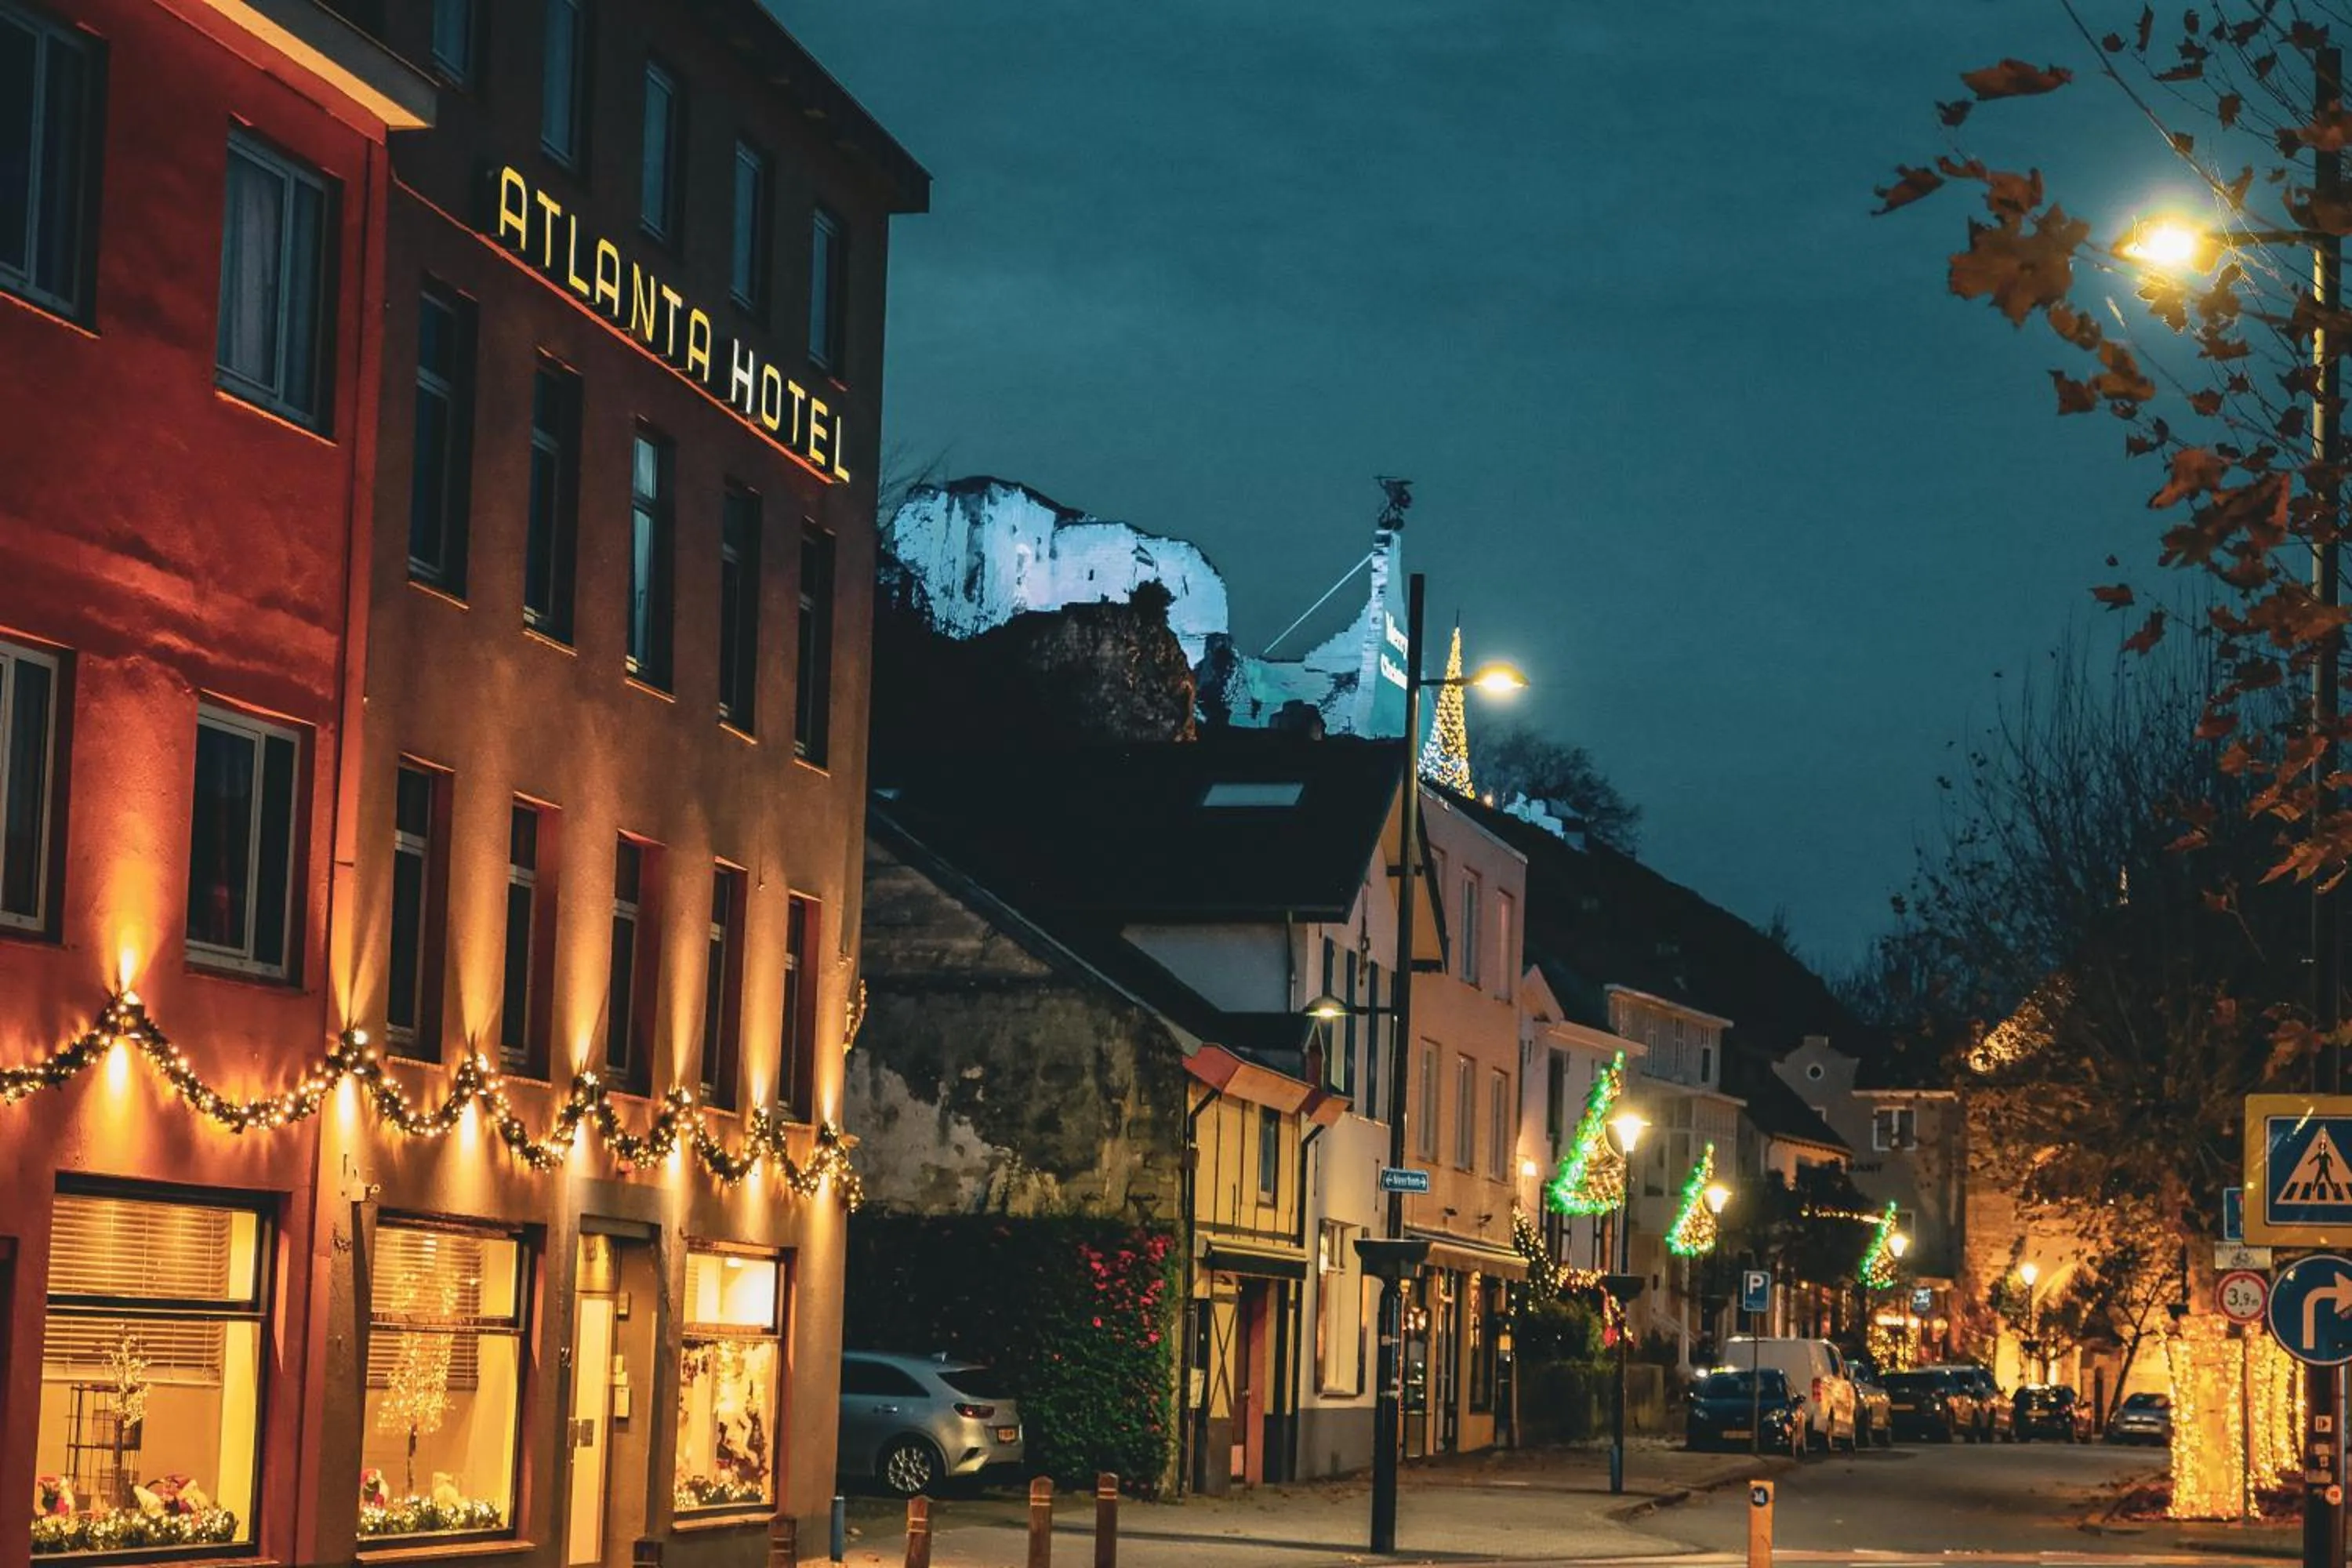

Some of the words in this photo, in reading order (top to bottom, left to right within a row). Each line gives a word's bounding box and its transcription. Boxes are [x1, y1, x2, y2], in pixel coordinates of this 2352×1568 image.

[499, 164, 712, 383] ATLANTA
[730, 337, 851, 483] HOTEL
[1748, 1274, 1765, 1295] P
